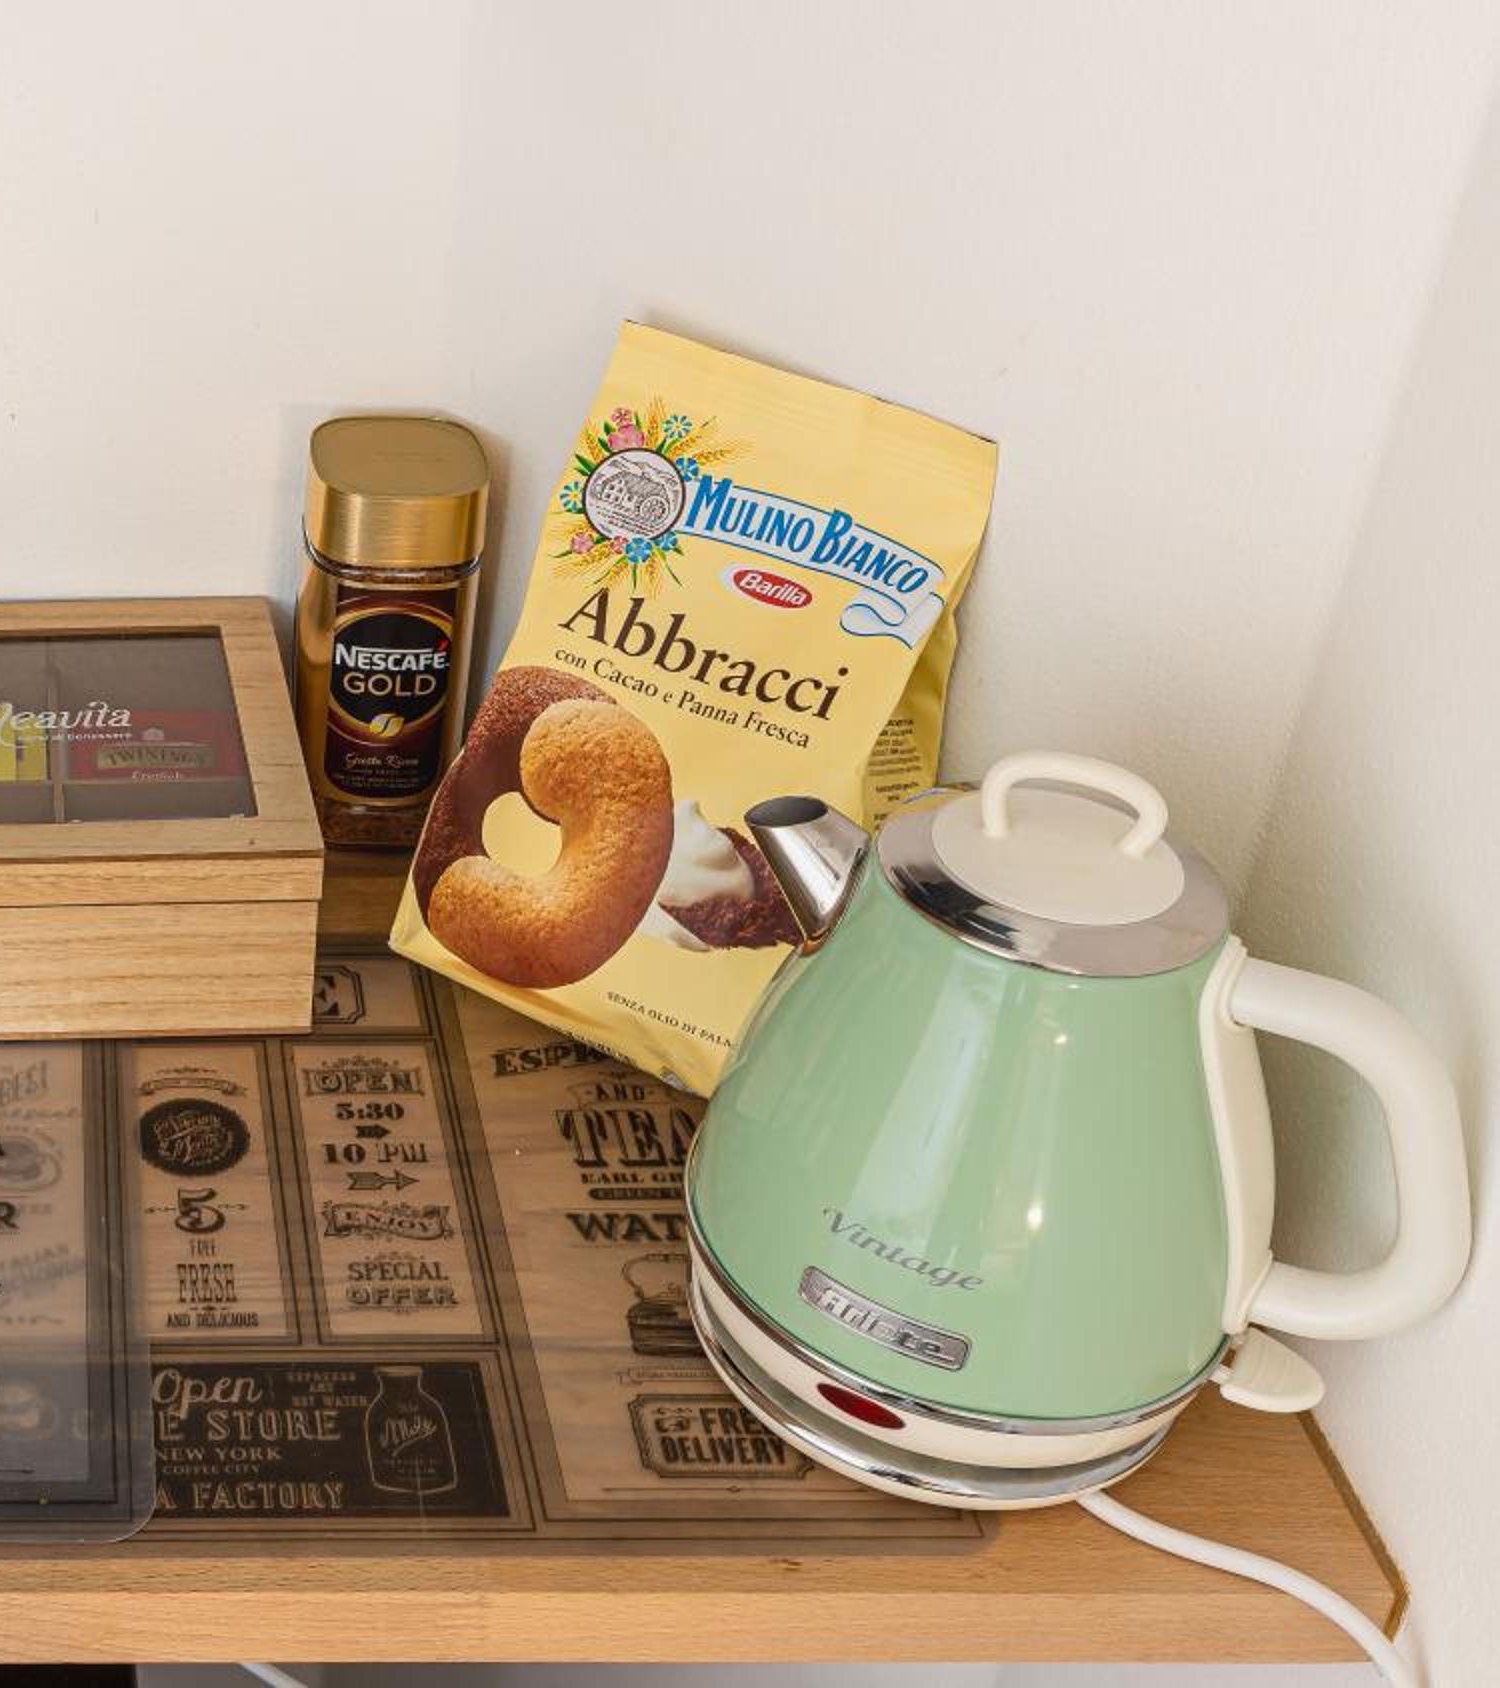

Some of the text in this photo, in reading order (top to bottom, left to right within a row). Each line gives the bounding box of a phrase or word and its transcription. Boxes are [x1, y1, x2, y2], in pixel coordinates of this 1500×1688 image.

[685, 475, 929, 594] MULINO BIANCO
[739, 572, 807, 606] Barilla
[557, 586, 849, 721] Abbracci
[343, 672, 436, 697] GOLD
[554, 647, 811, 749] con Cacao e Panna Fresca
[607, 991, 645, 1014] SENZA
[648, 1008, 679, 1027] OLIO
[681, 1023, 697, 1035] DI
[315, 1069, 415, 1094] OPEN
[335, 1102, 405, 1121] 5:30
[323, 1143, 366, 1164] 10
[174, 1187, 226, 1234] 5
[343, 1209, 432, 1233] ENJOY
[822, 1206, 985, 1291] Vintage
[175, 1263, 237, 1303] FRESH
[347, 1261, 449, 1282] SPECIAL
[345, 1286, 460, 1307] OFFER
[153, 1368, 264, 1419] Open
[207, 1410, 342, 1441] STORE
[214, 1447, 283, 1461] YORK
[659, 1436, 788, 1465] DELIVERY
[192, 1481, 345, 1510] FACTORY
